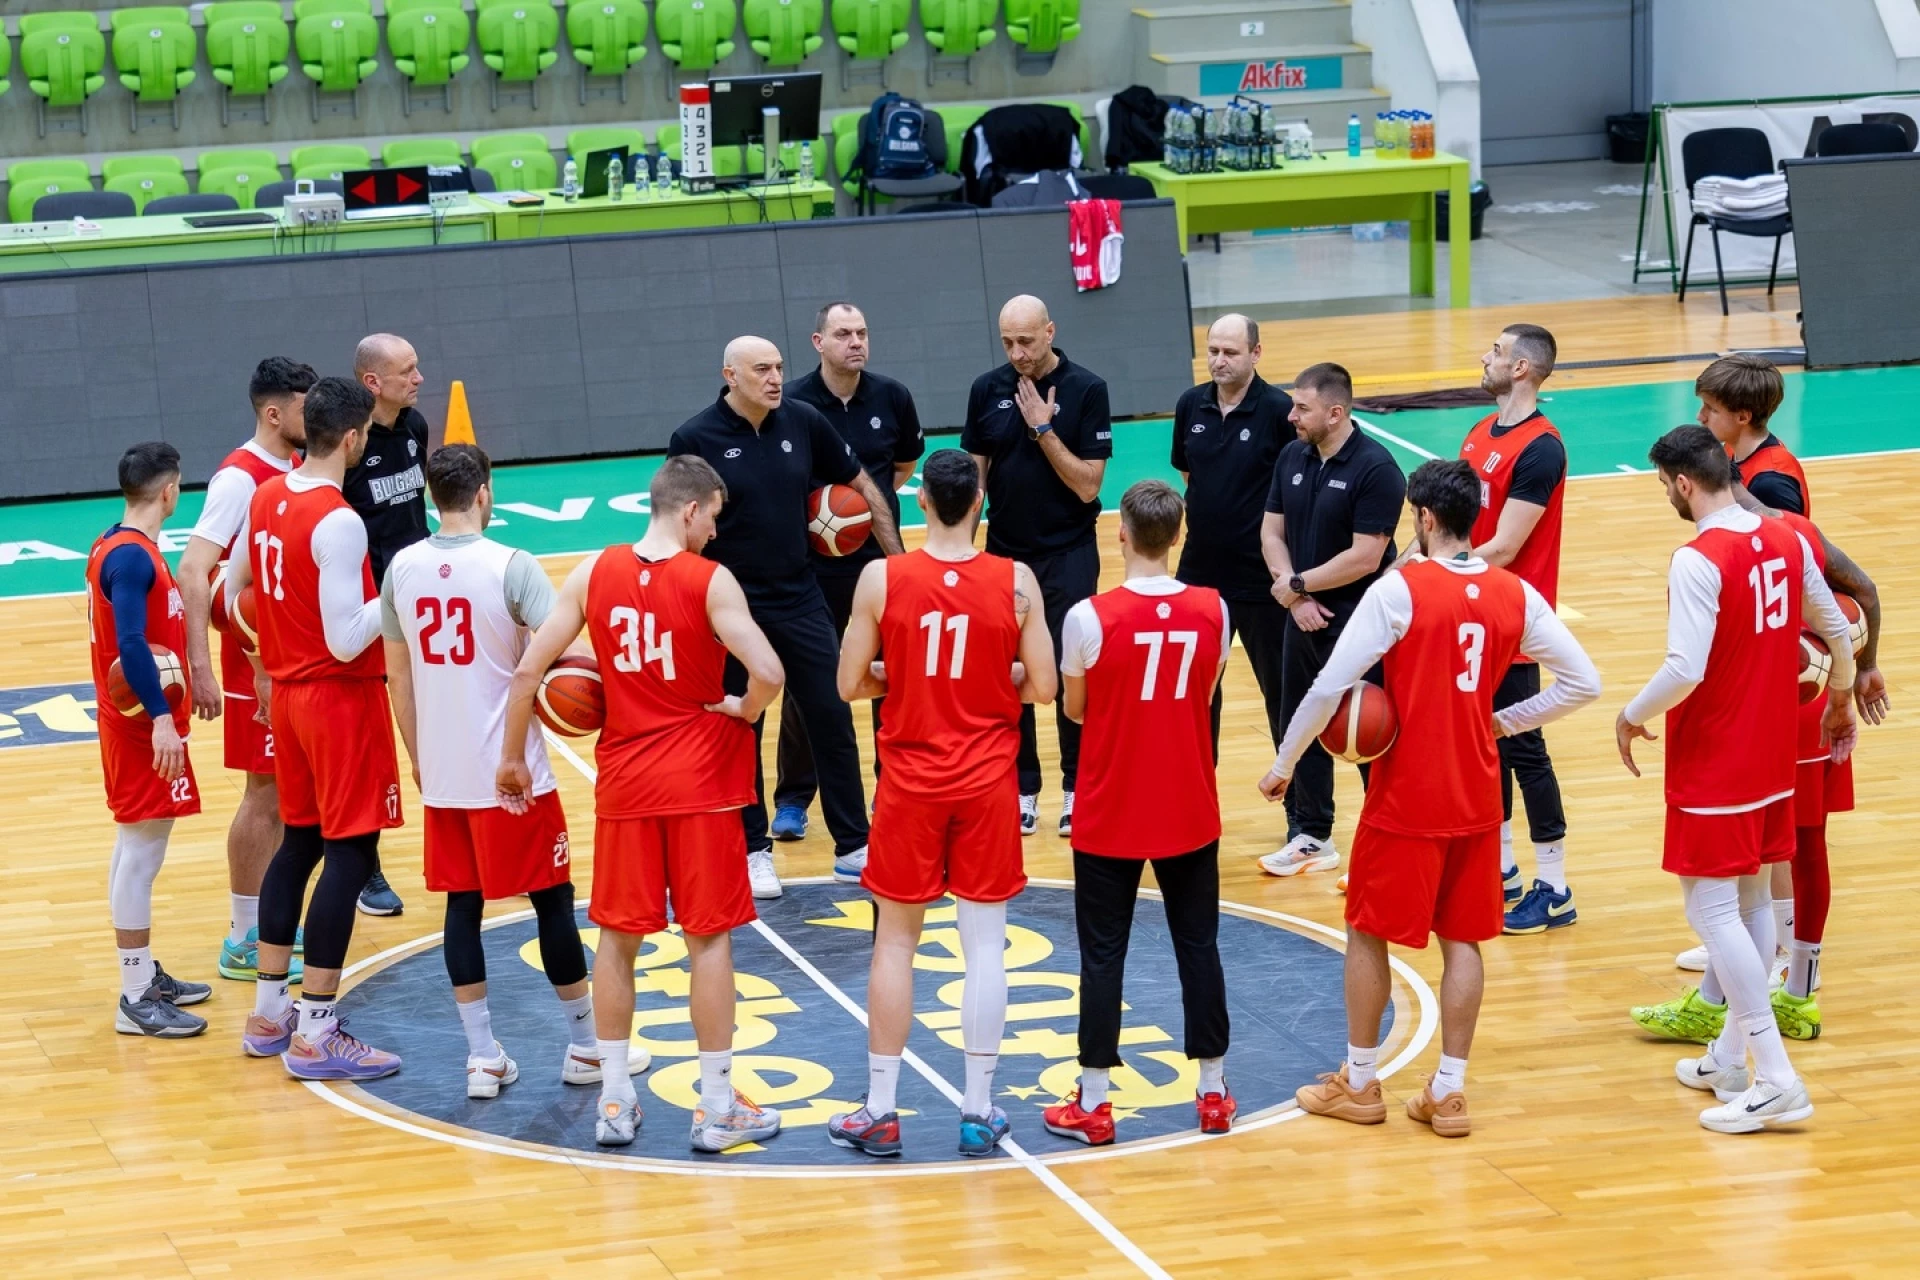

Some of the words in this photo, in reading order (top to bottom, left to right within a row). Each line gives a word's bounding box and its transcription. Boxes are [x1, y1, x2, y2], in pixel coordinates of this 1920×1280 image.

[1248, 24, 1257, 35] 2
[1239, 61, 1306, 91] Akfix
[696, 107, 705, 120] 4
[696, 124, 706, 138] 3
[696, 142, 706, 156] 2
[698, 160, 708, 173] 1
[1482, 450, 1502, 474] 10
[368, 463, 425, 504] BULGARIA
[254, 530, 285, 601] 17
[1748, 557, 1789, 635] 15
[415, 597, 476, 666] 23
[609, 606, 676, 681] 34
[919, 610, 969, 680] 11
[1134, 630, 1198, 702] 77
[1456, 622, 1485, 693] 3
[171, 777, 192, 802] 22
[386, 794, 398, 819] 17
[553, 841, 569, 868] 23
[123, 957, 140, 966] 23
